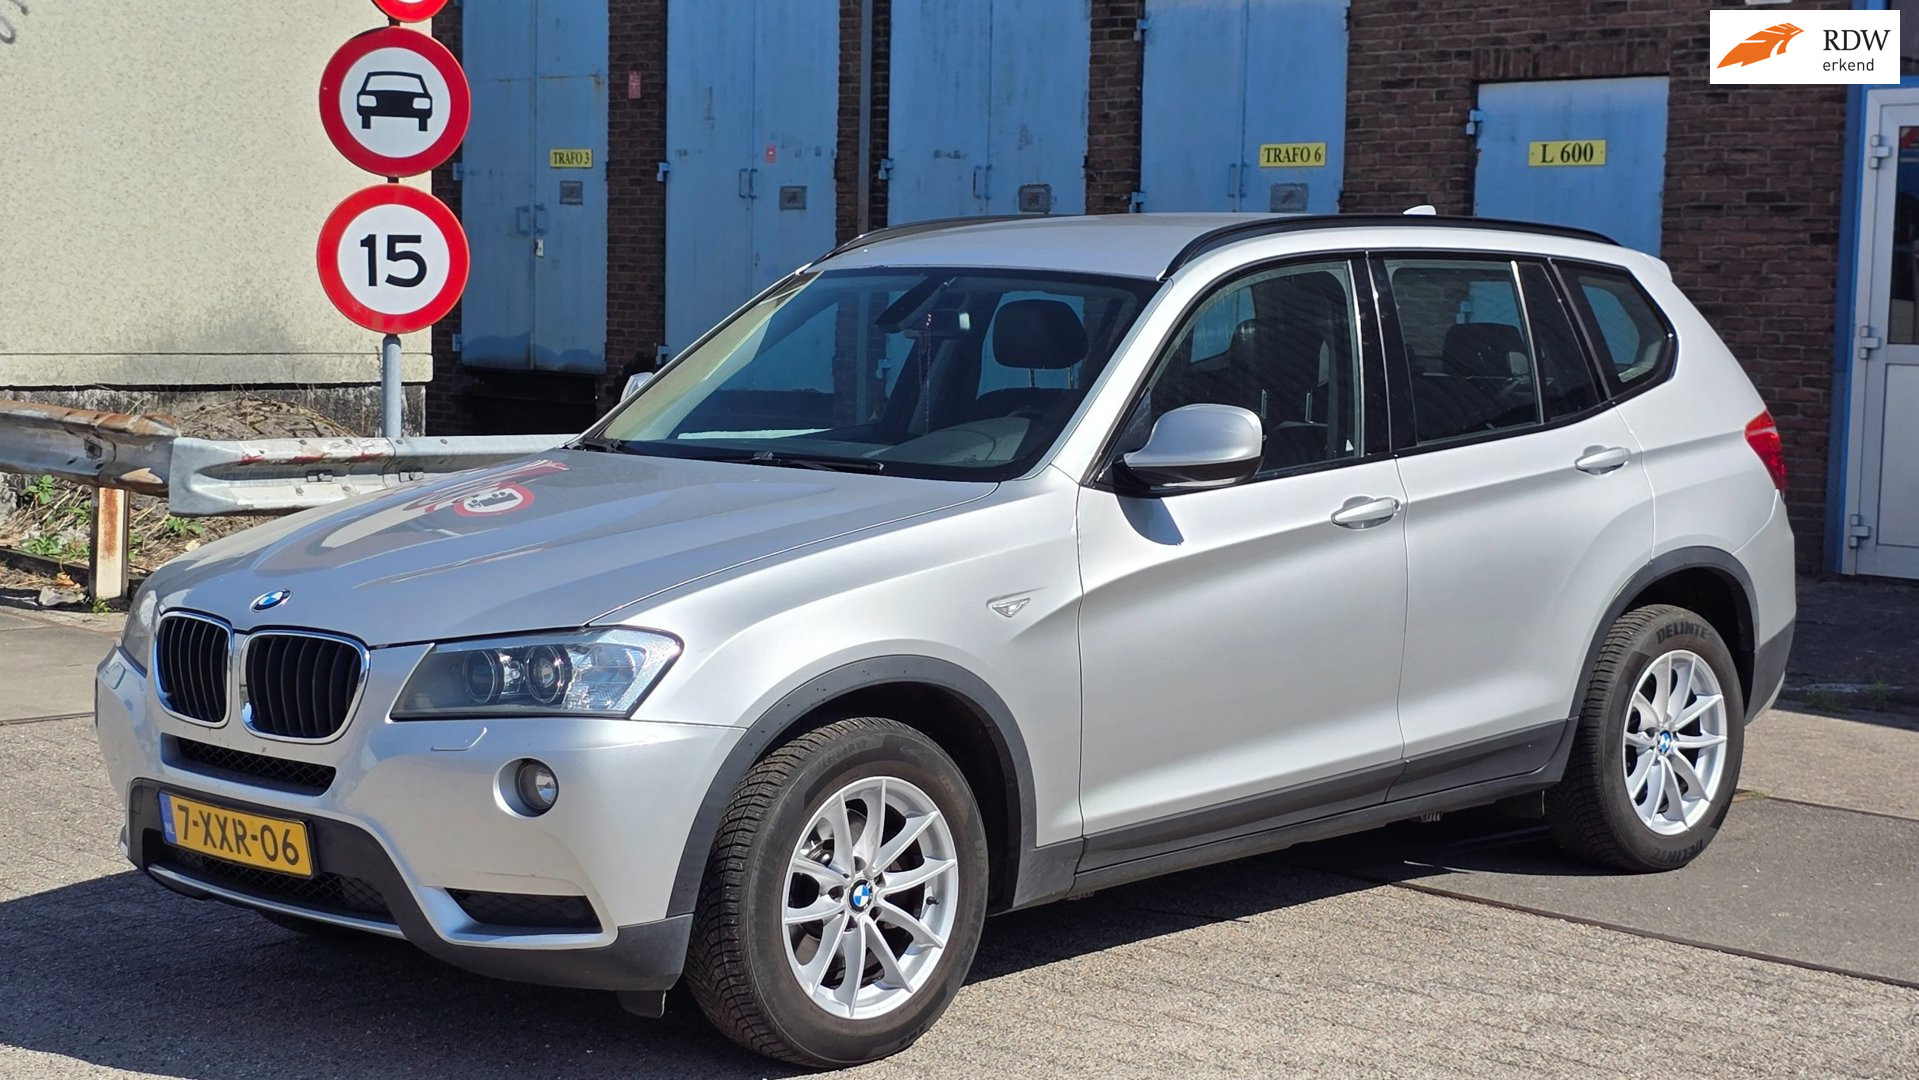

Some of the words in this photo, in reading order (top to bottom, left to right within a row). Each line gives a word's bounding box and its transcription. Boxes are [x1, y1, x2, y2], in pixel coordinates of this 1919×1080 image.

[553, 151, 583, 165] TRAFO
[583, 151, 590, 165] 3
[1264, 147, 1311, 163] TRAFO
[1314, 147, 1322, 163] 6
[1540, 143, 1555, 163] L
[1560, 142, 1594, 163] 600
[360, 233, 427, 288] 15
[1655, 621, 1709, 644] DELINTE
[164, 822, 175, 835] NL
[177, 803, 300, 866] 7-XXR-06
